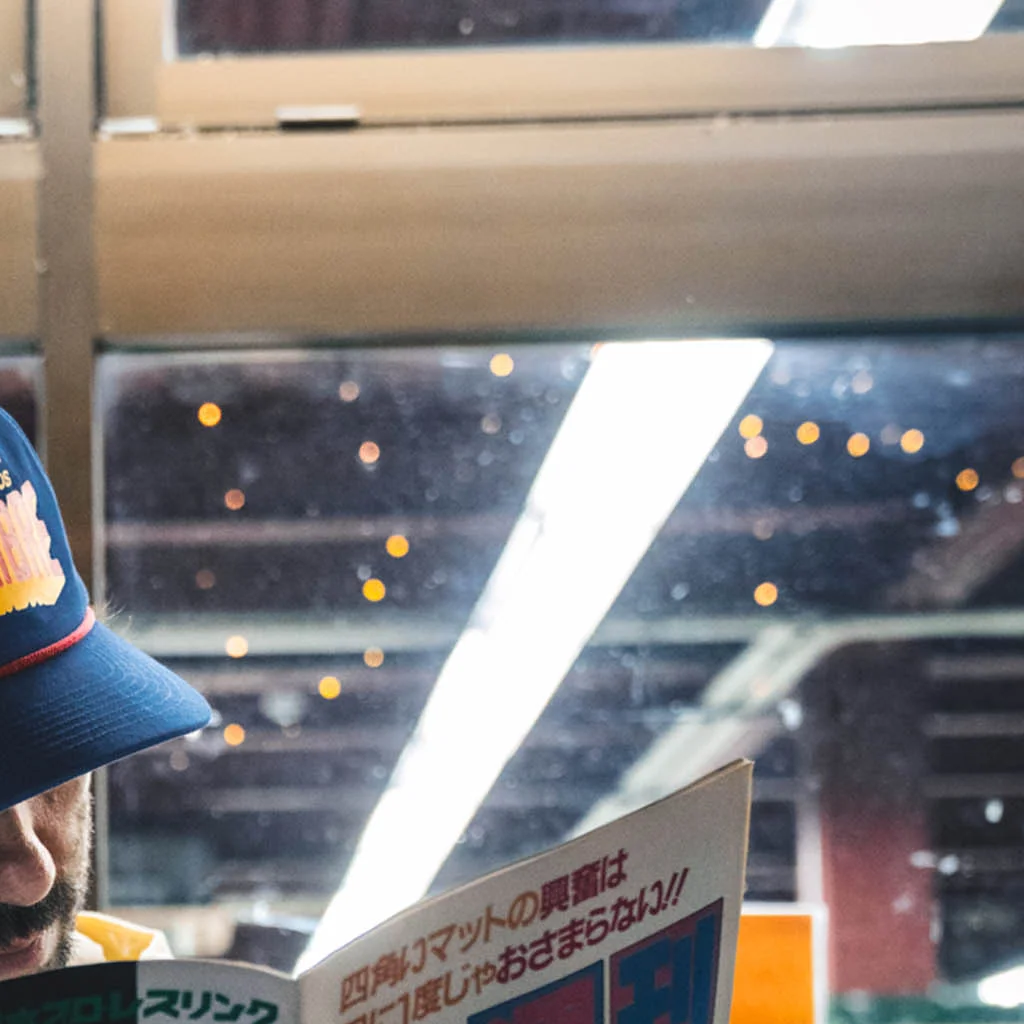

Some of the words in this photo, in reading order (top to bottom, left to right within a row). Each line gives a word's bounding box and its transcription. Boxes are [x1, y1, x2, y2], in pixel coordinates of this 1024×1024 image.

[339, 848, 629, 1014] 四角いマットの興奮は
